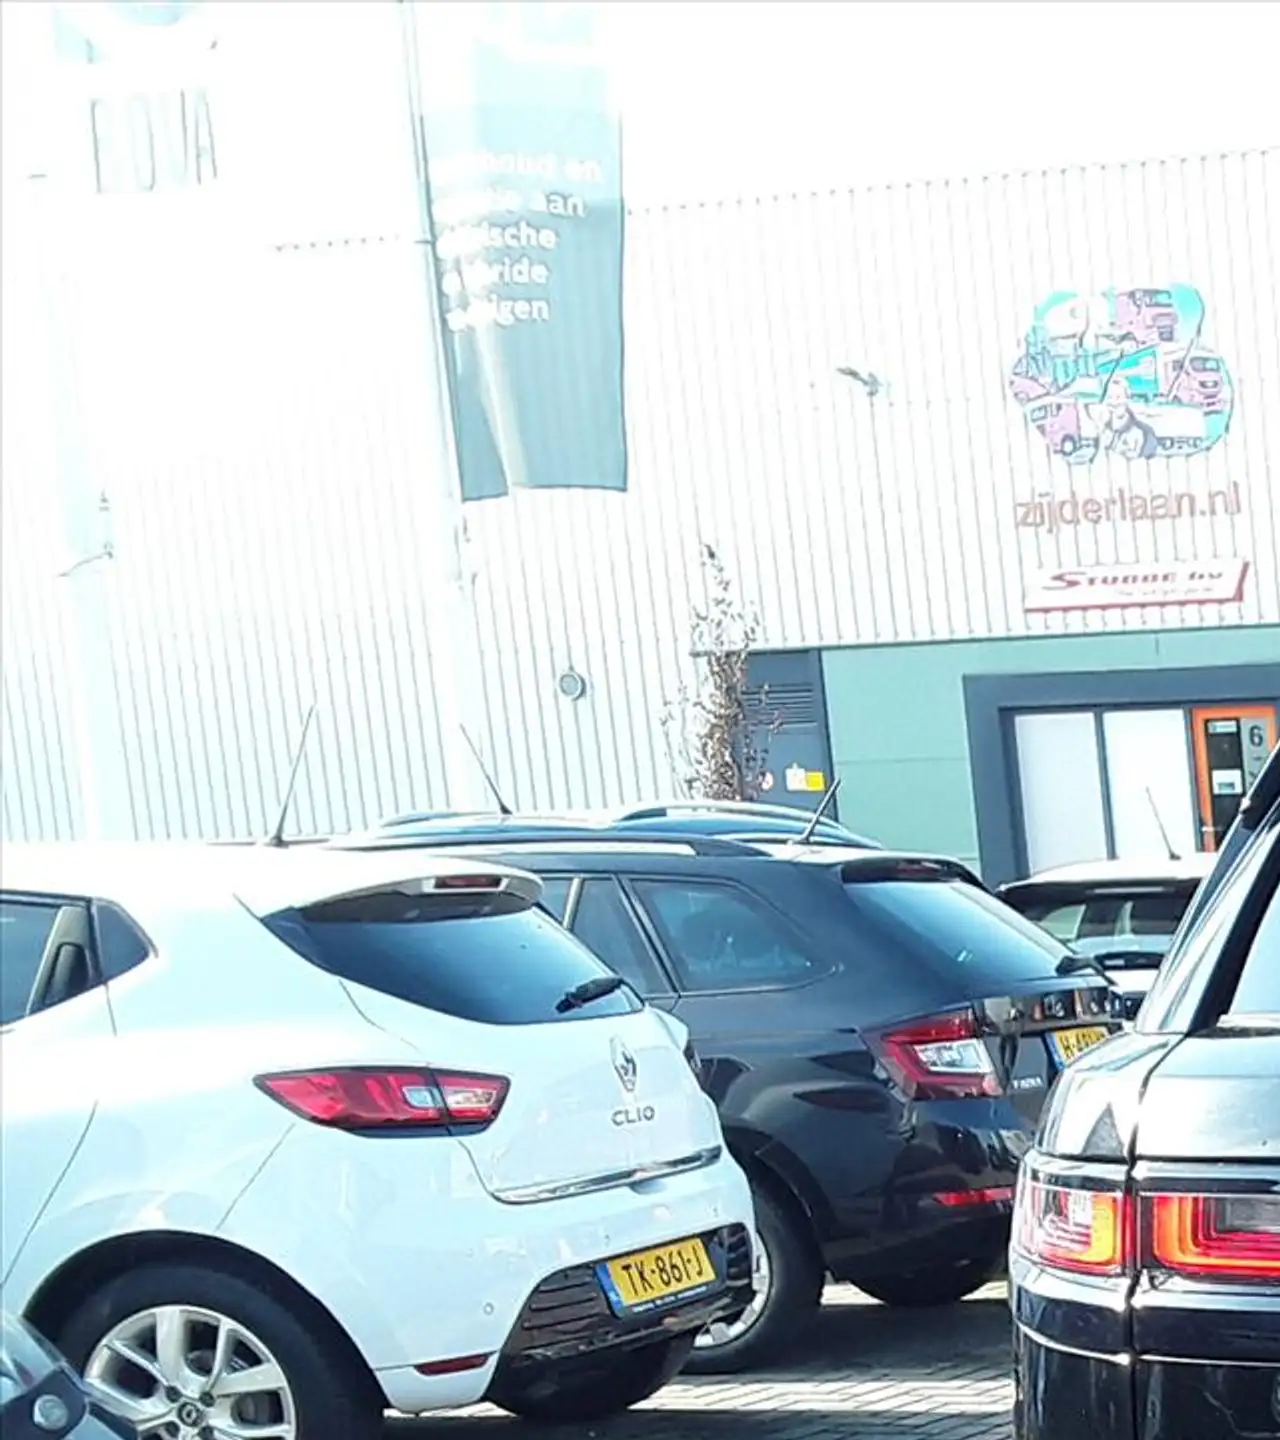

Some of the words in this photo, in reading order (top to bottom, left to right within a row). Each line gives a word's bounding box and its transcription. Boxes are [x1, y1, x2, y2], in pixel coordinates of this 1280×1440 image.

[1015, 481, 1241, 533] zijderlaan.nl
[1249, 725, 1264, 747] 6
[611, 1106, 656, 1126] CLIO
[620, 1246, 703, 1297] TK-861-J
